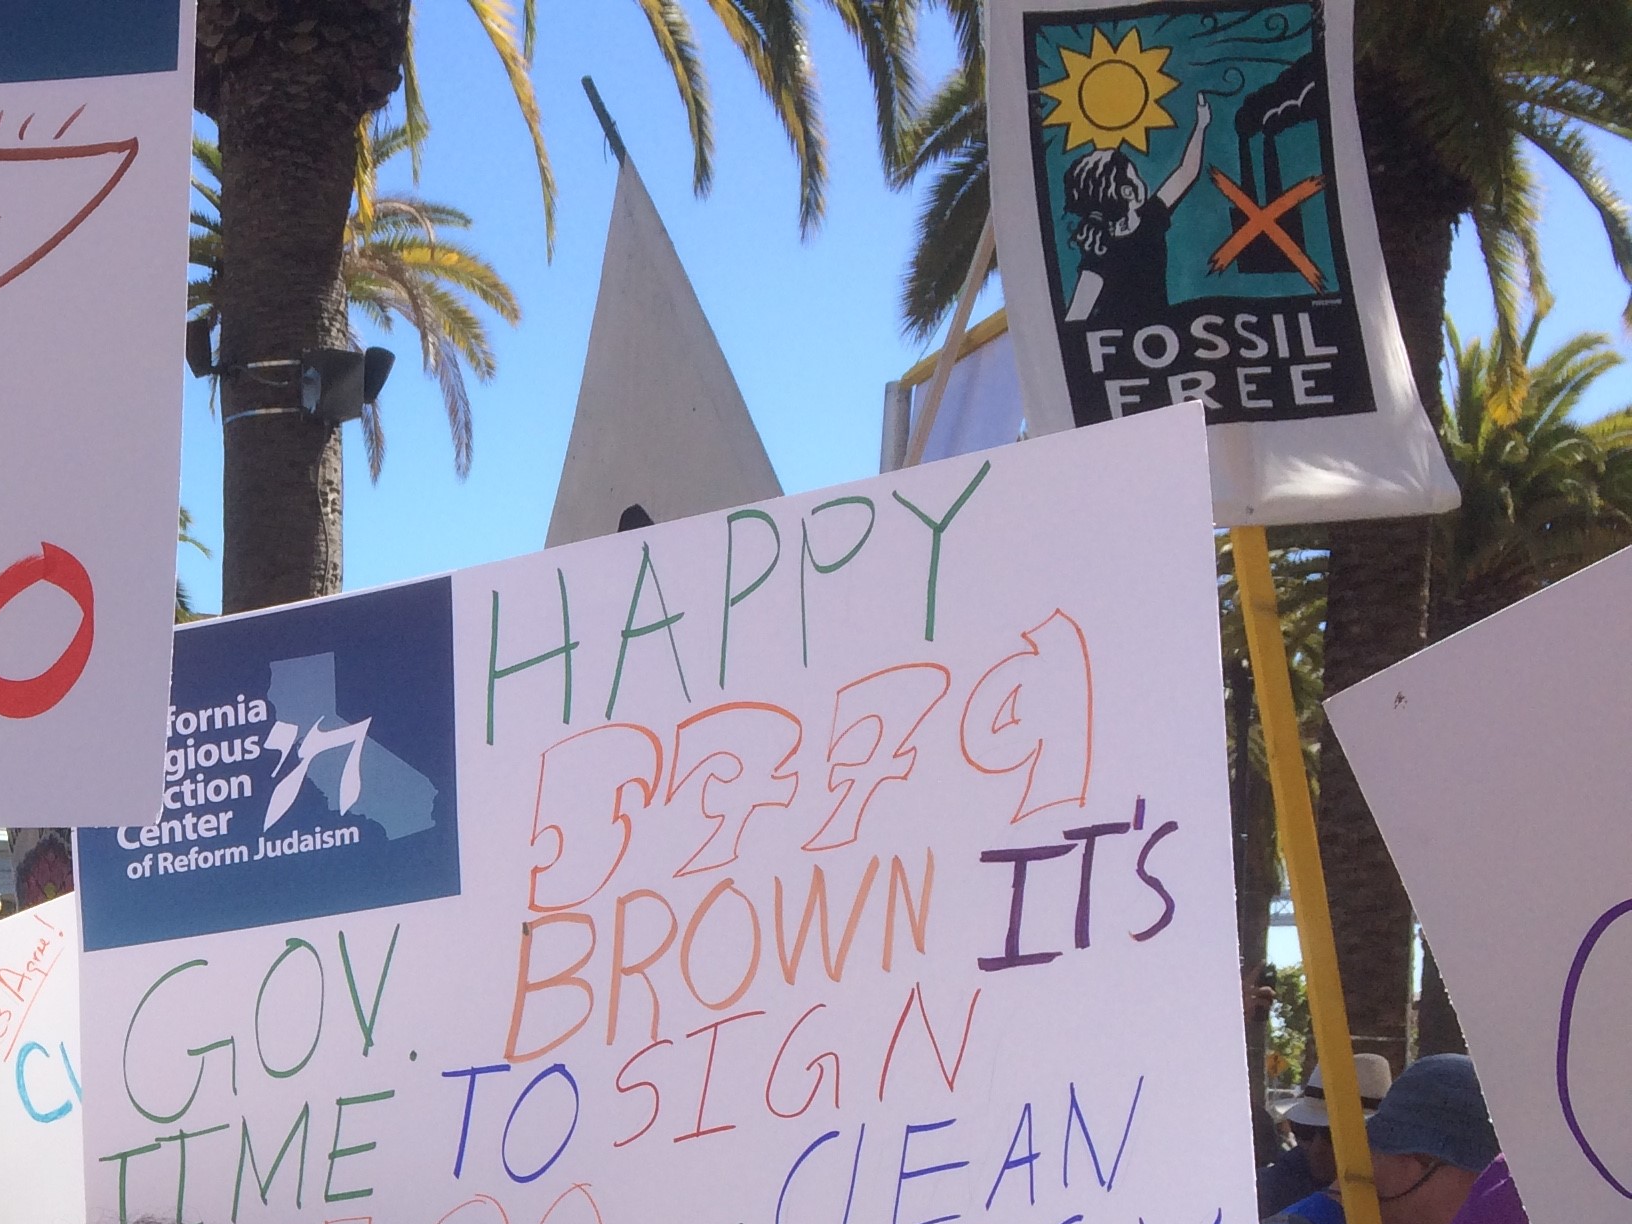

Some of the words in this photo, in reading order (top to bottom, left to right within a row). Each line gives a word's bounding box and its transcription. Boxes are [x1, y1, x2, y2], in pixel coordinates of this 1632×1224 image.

[1086, 312, 1338, 374] FOSSIL
[1105, 362, 1336, 419] FREE
[486, 460, 991, 745] HAPPY
[167, 694, 267, 738] fornia
[165, 735, 261, 782] gious
[163, 773, 252, 810] ction
[117, 810, 233, 850] Center
[126, 852, 153, 880] of
[157, 841, 249, 875] Reform
[253, 823, 360, 861] Judaism
[503, 847, 935, 1064] BROWN
[977, 795, 1178, 971] IT'S
[123, 923, 418, 1123] GOV.
[442, 1063, 579, 1184] TO
[613, 981, 982, 1147] SIGN
